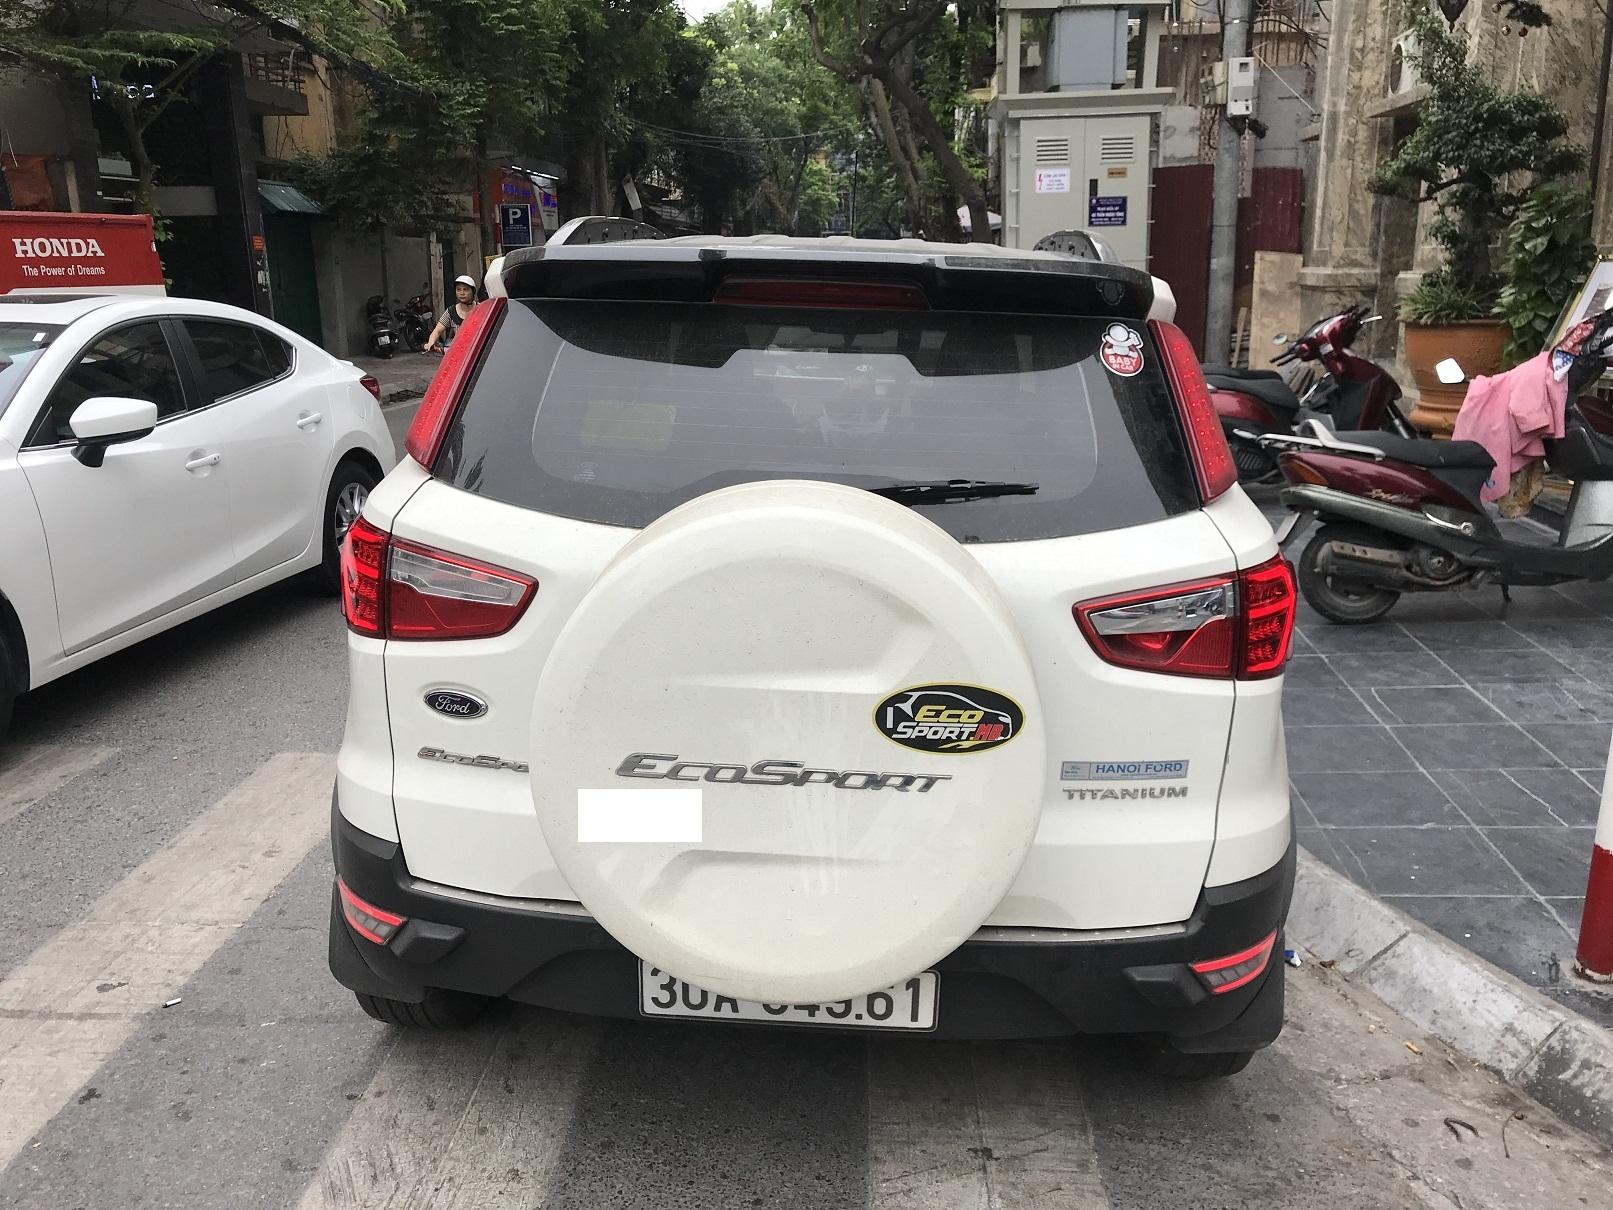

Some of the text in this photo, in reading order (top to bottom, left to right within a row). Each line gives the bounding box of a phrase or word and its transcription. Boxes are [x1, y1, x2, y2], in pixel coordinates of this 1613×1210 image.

[508, 208, 521, 224] P
[12, 237, 105, 257] HONDA
[22, 264, 106, 277] The Power of Dreams
[1109, 356, 1137, 366] BABY
[435, 695, 471, 714] Ford
[1145, 762, 1183, 773] FORD
[1063, 786, 1189, 800] TITANIUM
